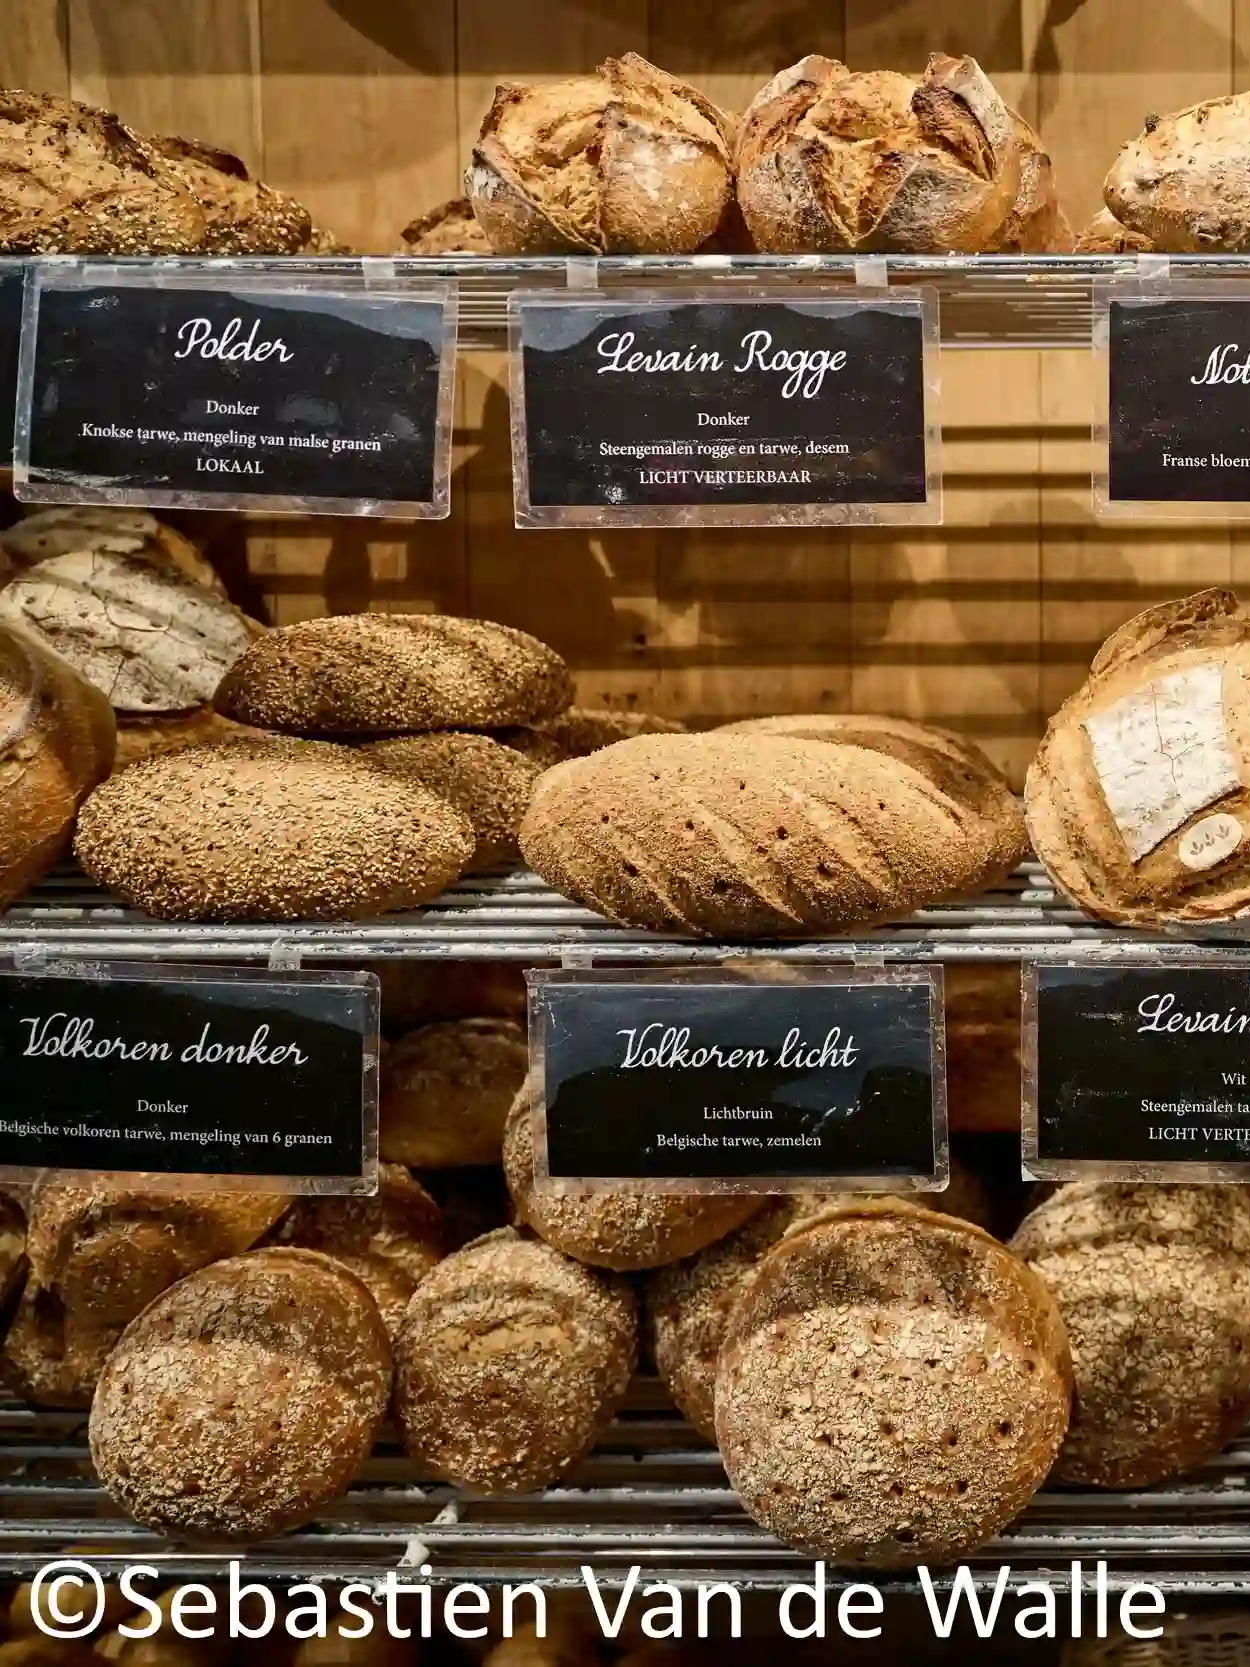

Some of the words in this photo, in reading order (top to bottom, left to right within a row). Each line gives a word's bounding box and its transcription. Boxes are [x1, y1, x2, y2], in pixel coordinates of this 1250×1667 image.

[174, 318, 294, 363] Polder
[597, 331, 723, 374] Levain
[734, 330, 846, 398] Rogge
[206, 400, 259, 416] Donker
[697, 412, 750, 426] Donker
[82, 423, 134, 438] Knokse
[137, 428, 180, 442] tarwe,
[184, 430, 256, 447] mengeling
[260, 435, 284, 446] van
[288, 433, 329, 449] malse
[332, 437, 381, 453] granen
[599, 442, 693, 459] Steengemalen
[697, 444, 735, 459] rogge
[738, 444, 755, 454] en
[760, 442, 801, 456] tarwe,
[805, 441, 849, 454] desem
[196, 458, 264, 474] LOKAAL
[1162, 454, 1208, 467] Franse
[639, 471, 689, 484] LICHT
[694, 470, 812, 484] VERTEERBAAR
[20, 1013, 173, 1061] Volkoren
[181, 1022, 309, 1065] donker
[617, 1023, 768, 1069] Volkoren
[774, 1027, 860, 1068] licht
[1221, 1072, 1246, 1085] Wit
[137, 1100, 189, 1113] Donker
[704, 1106, 773, 1120] Lichtbruin
[1141, 1099, 1233, 1116] Steengemalen
[0, 1120, 59, 1136] Belgische
[62, 1124, 121, 1139] volkoren
[124, 1127, 165, 1141] tarwe,
[170, 1129, 241, 1146] mengeling
[245, 1133, 268, 1143] van
[272, 1131, 281, 1143] 6
[284, 1133, 332, 1147] granen
[656, 1133, 719, 1148] Belgische
[722, 1135, 763, 1147] tarwe,
[767, 1134, 821, 1146] zemelen
[1149, 1127, 1198, 1140] LICHT
